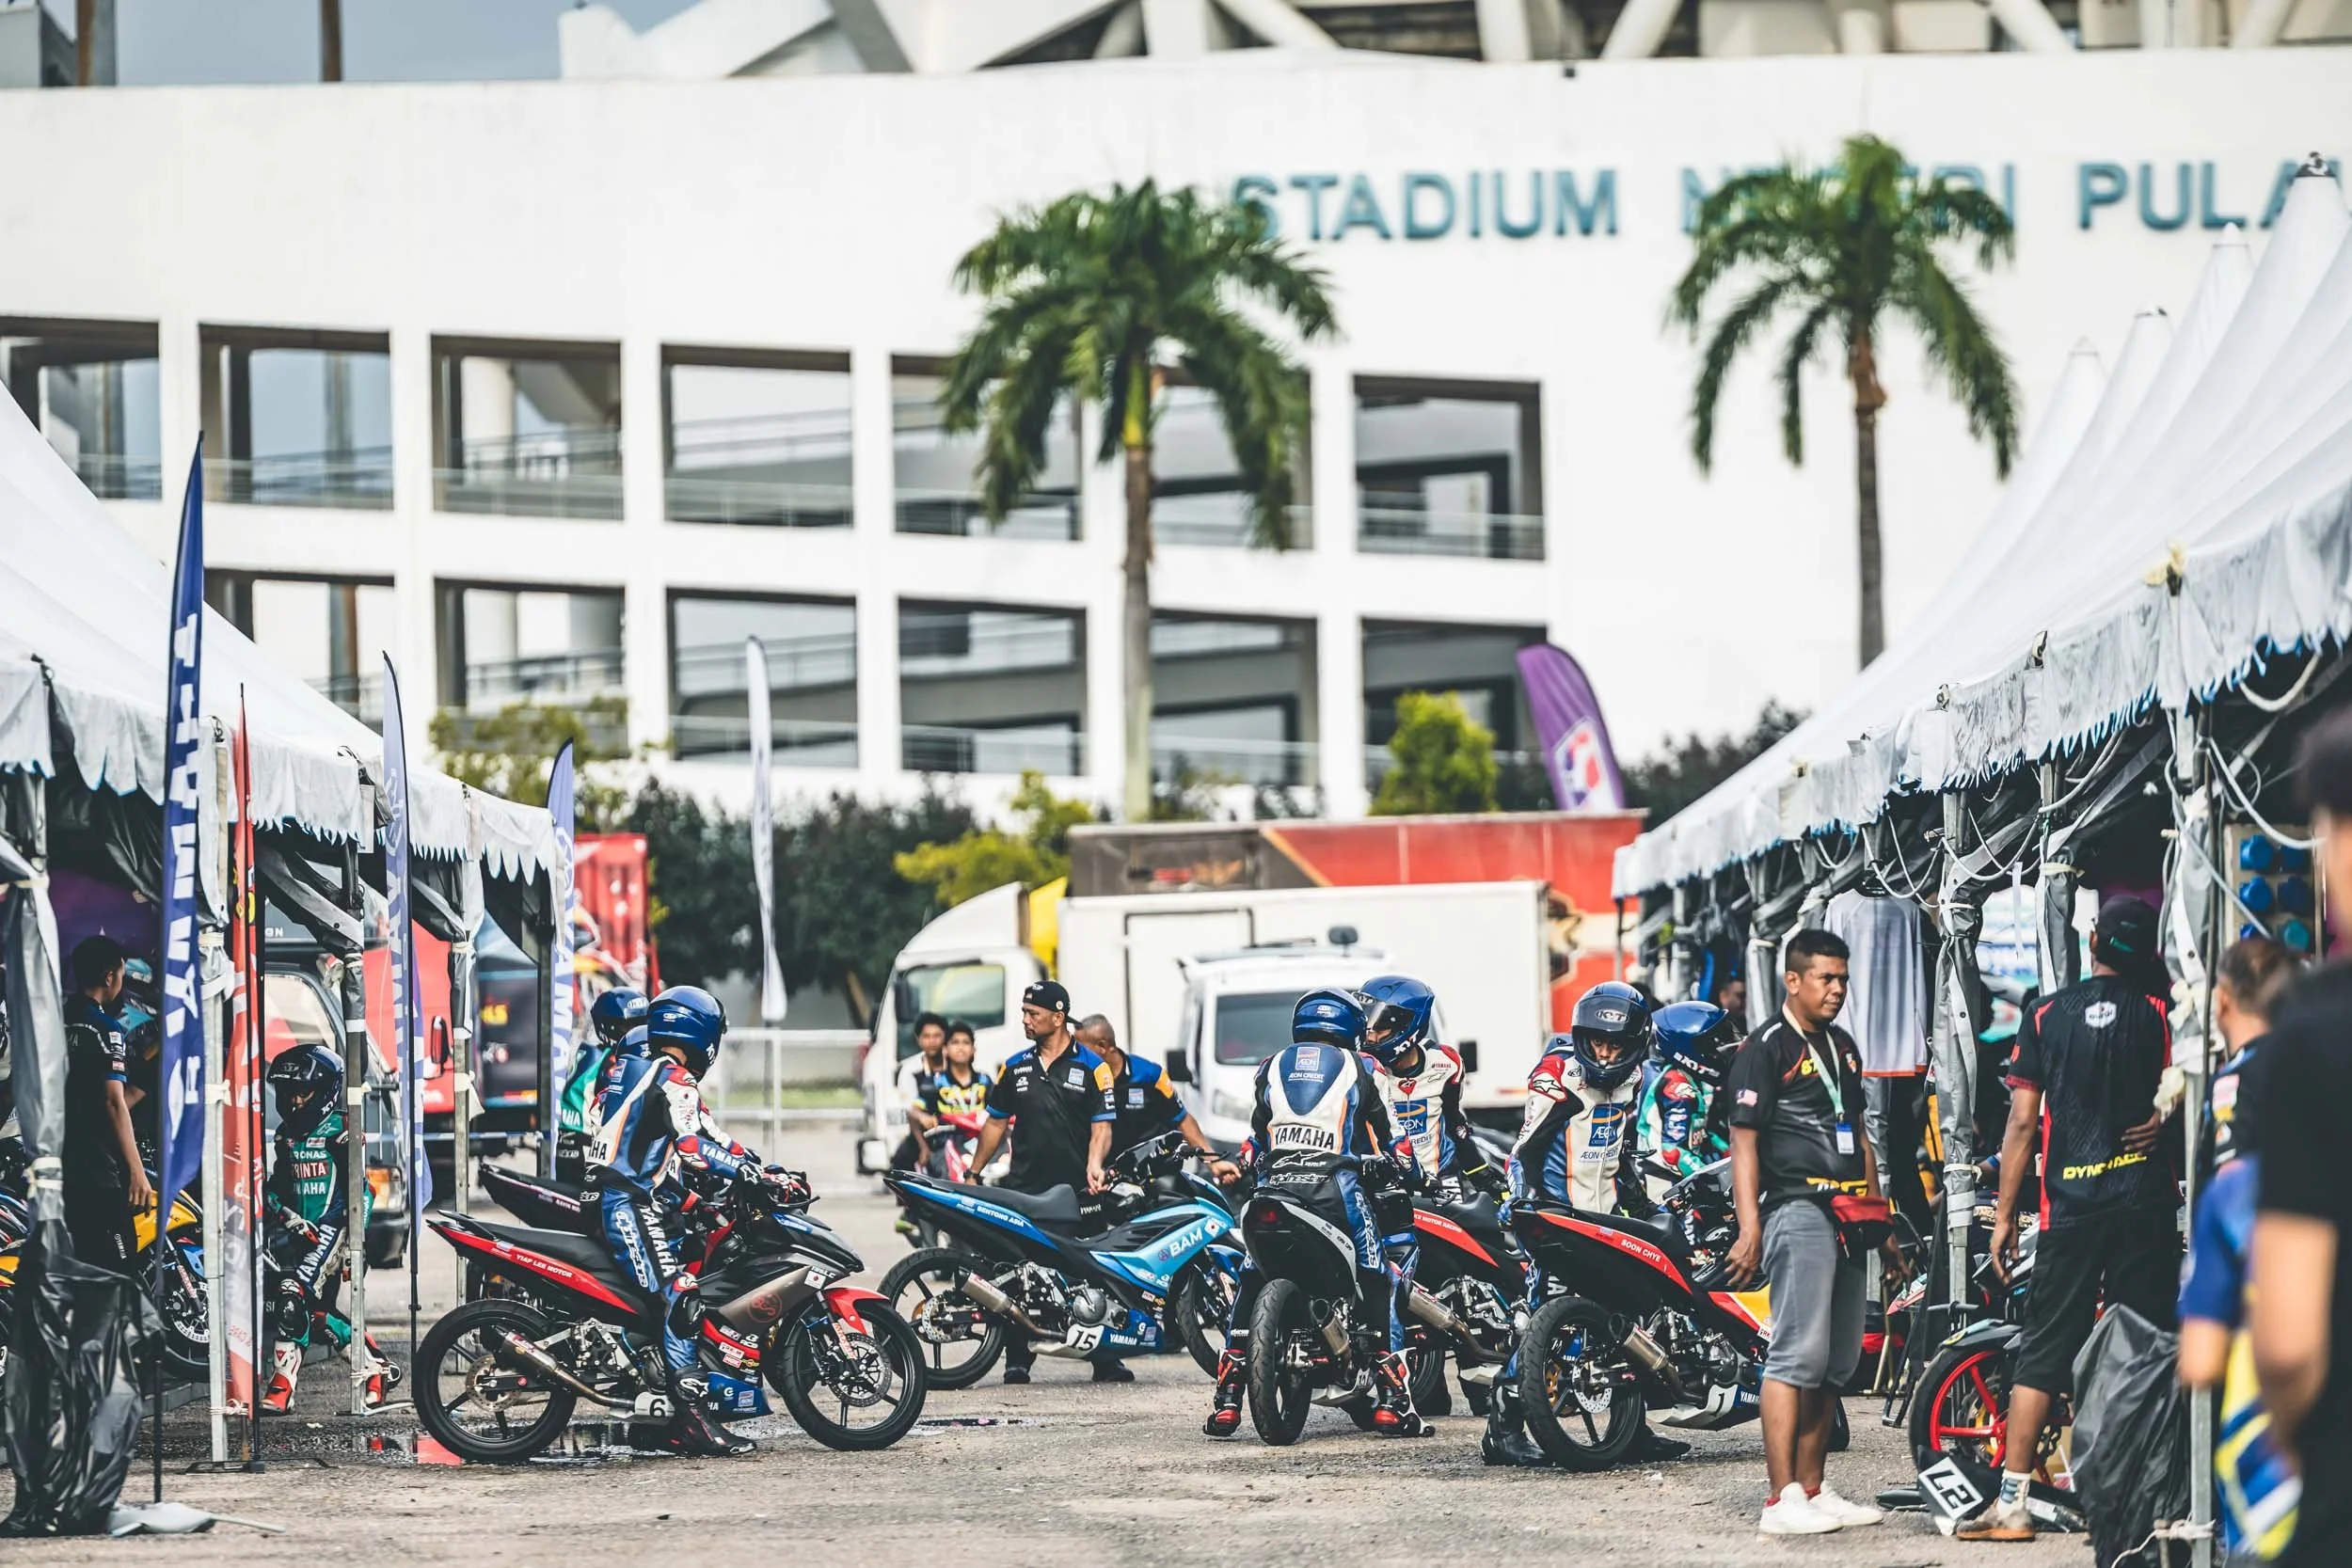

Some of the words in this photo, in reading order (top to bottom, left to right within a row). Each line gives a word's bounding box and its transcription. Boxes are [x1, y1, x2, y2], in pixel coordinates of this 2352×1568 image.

[1232, 168, 1618, 242] STADIUM
[1275, 1127, 1335, 1150] YAMAHA
[268, 1224, 337, 1283] YAMAHA
[639, 1206, 677, 1277] YAMAHA
[1168, 1227, 1203, 1258] BAM
[1621, 1239, 1642, 1253] SOON
[1642, 1248, 1661, 1263] CHYE
[516, 1254, 533, 1264] YIAP
[533, 1259, 547, 1270] LEE
[547, 1265, 573, 1278] MOTOR
[1068, 1329, 1097, 1351] 15
[1110, 1333, 1137, 1346] YAMAHA
[649, 1399, 665, 1418] 6
